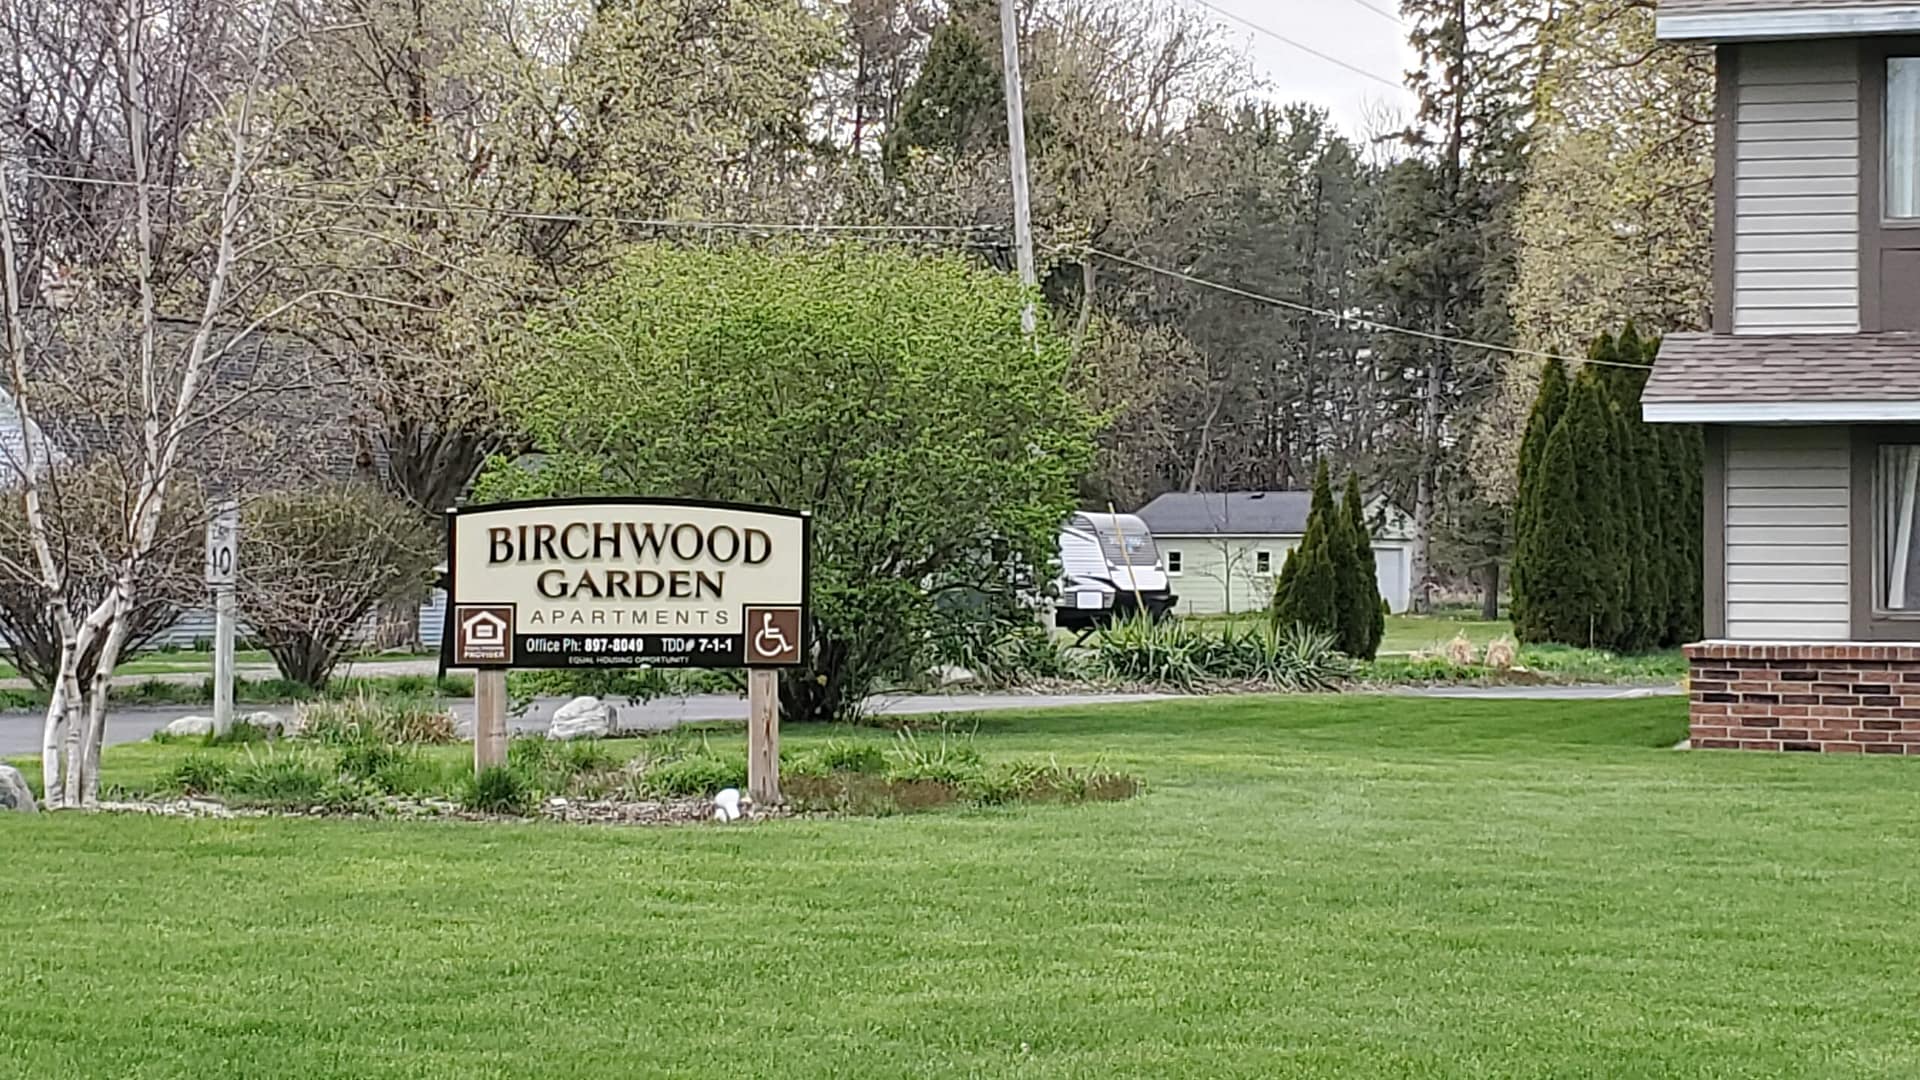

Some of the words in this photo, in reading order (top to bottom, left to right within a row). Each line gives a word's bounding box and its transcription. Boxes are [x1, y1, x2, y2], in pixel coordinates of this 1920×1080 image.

[488, 522, 772, 564] BIRCHWOOD
[212, 546, 232, 576] 10
[536, 568, 725, 599] GARDEN
[530, 610, 729, 625] APARTMENTS
[526, 637, 560, 652] Office
[562, 638, 582, 652] Ph:
[584, 638, 644, 652] 897-8049
[698, 638, 732, 652] 7-1-1
